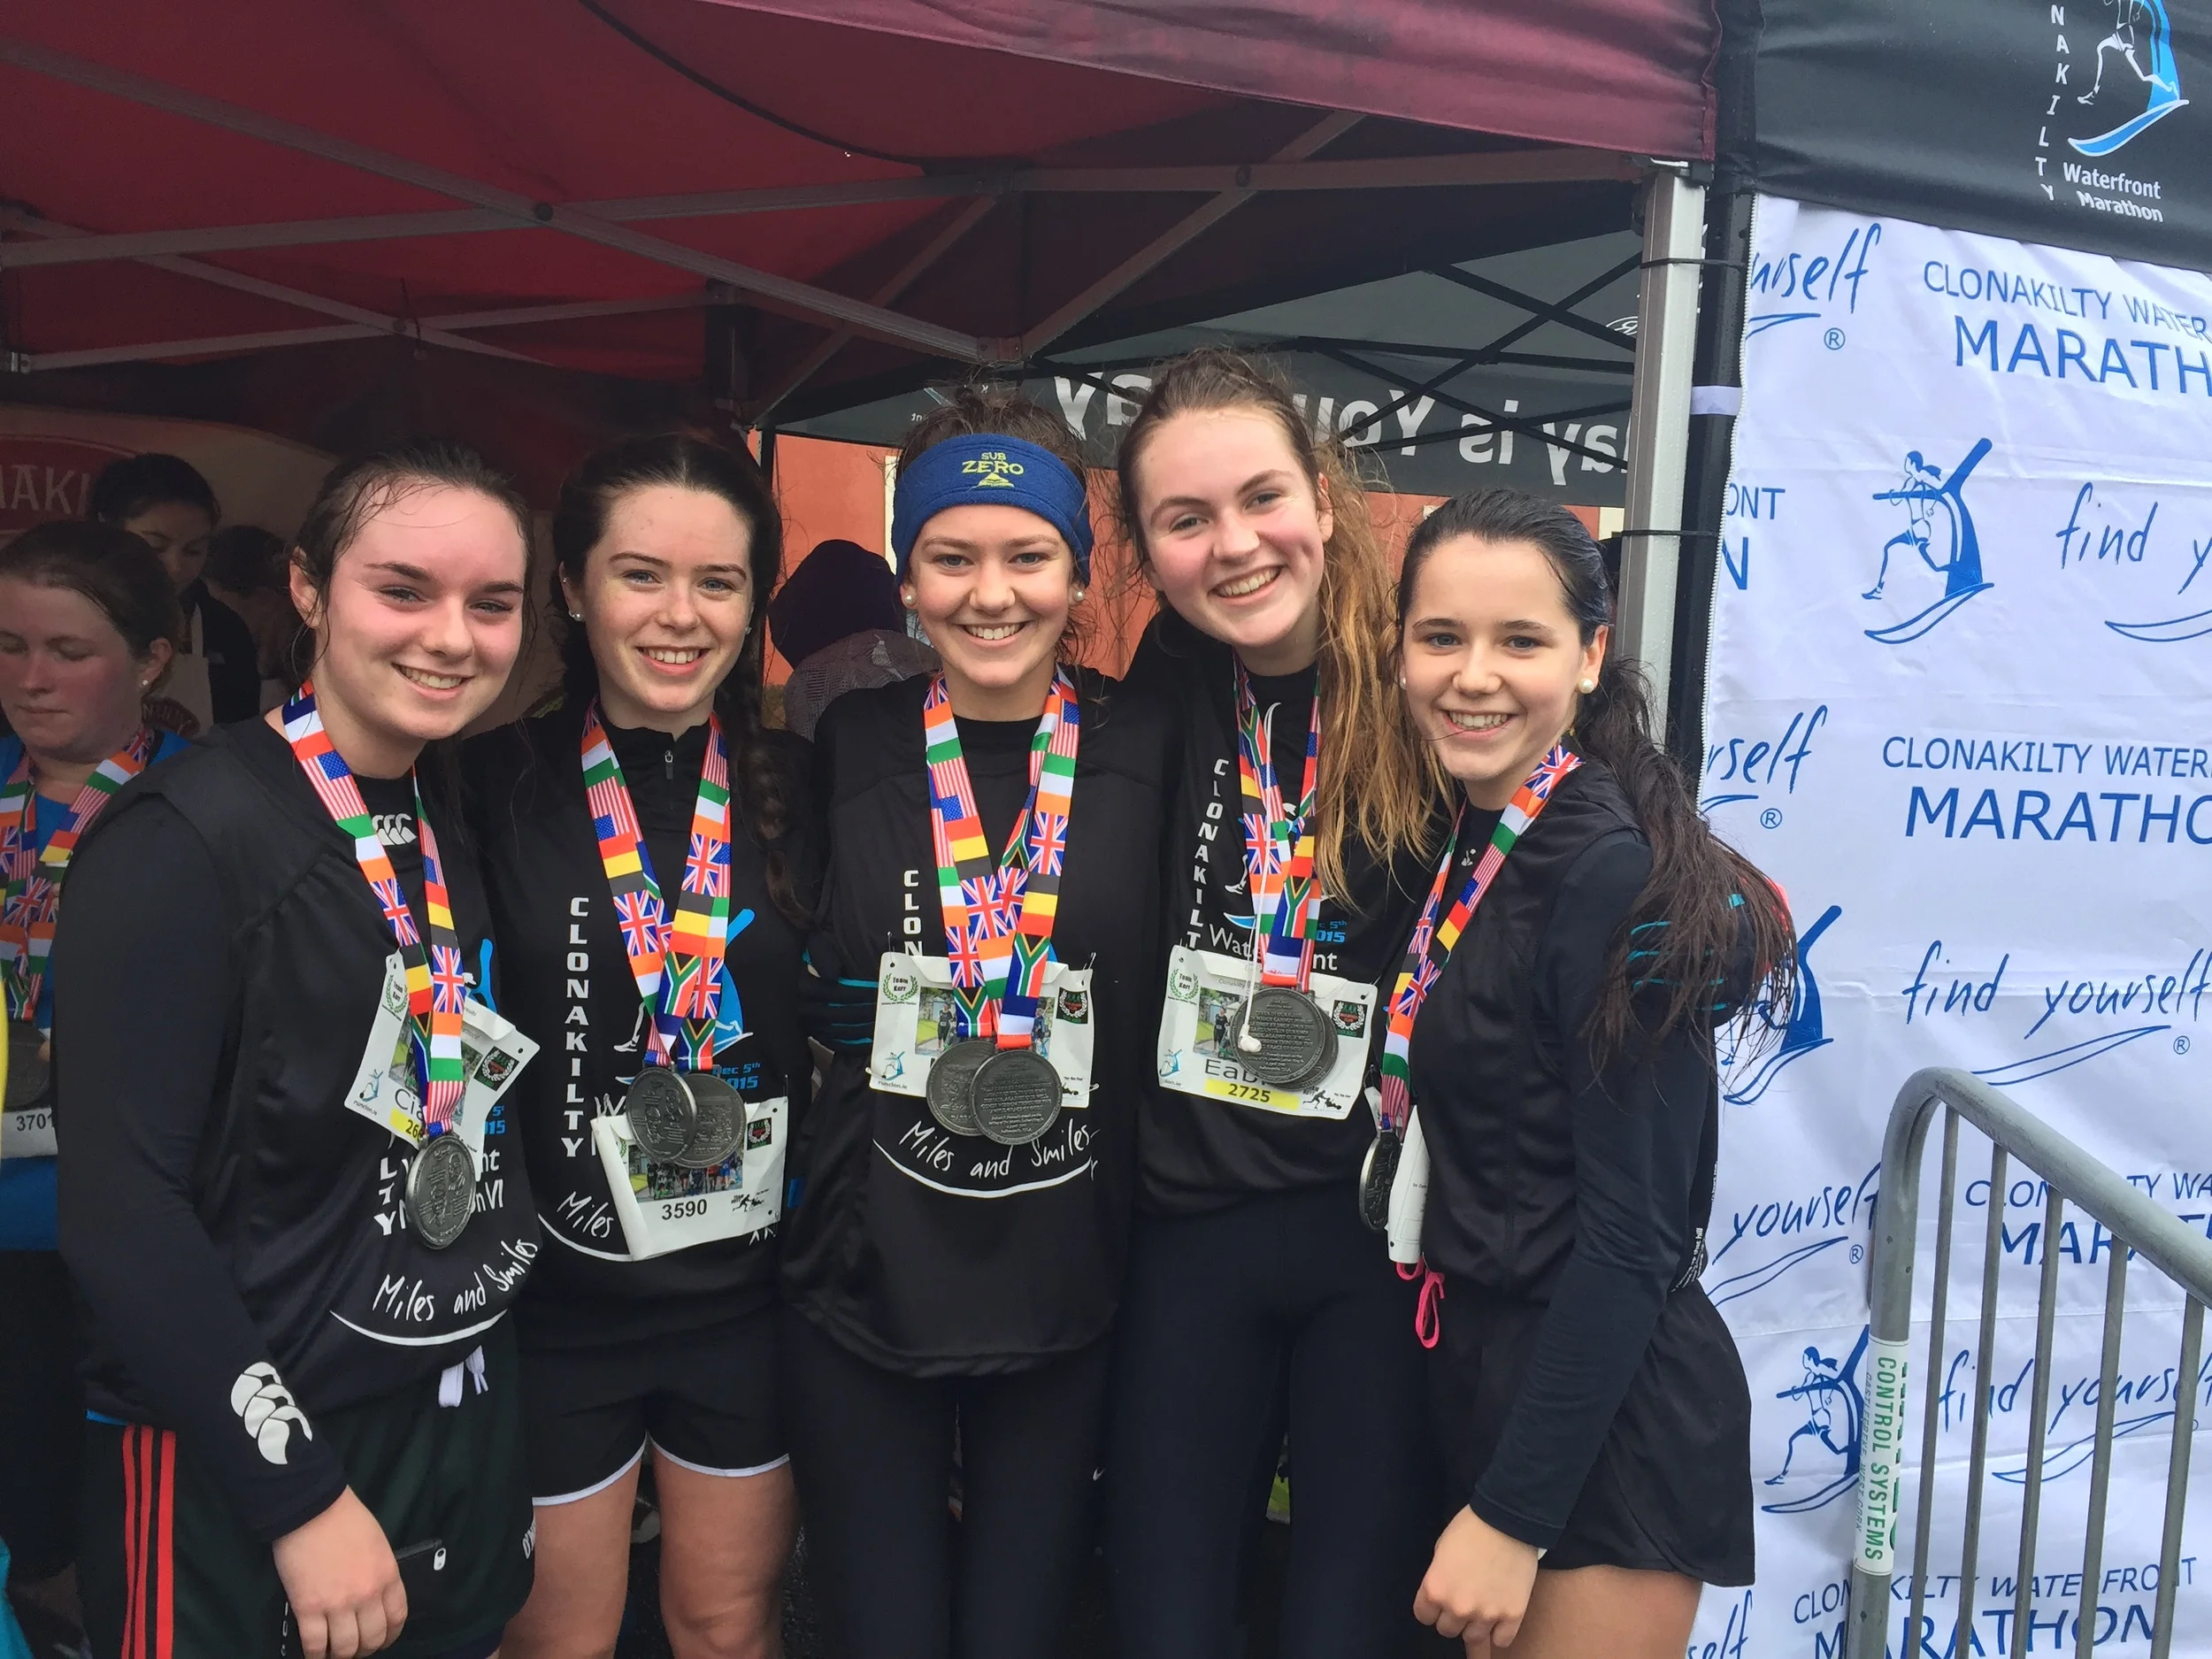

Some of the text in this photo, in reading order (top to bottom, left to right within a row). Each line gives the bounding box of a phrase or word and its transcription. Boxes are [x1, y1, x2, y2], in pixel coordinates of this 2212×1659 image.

[2062, 161, 2162, 200] Waterfront
[2076, 189, 2163, 223] Marathon
[1924, 260, 2113, 320] CLONAKILTY
[1953, 314, 2212, 398] MARATH
[961, 460, 1025, 476] ZERO
[980, 451, 1007, 461] SUB
[0, 465, 90, 518] AKI
[2055, 481, 2159, 571] find
[1882, 735, 2212, 779] CLONAKILTY WATER
[1316, 931, 1347, 943] 015
[1901, 940, 2212, 1040] find yourself
[560, 896, 591, 1158] CLONAKILTY
[726, 1075, 760, 1091] 015
[1227, 1082, 1271, 1103] 2725
[898, 1119, 955, 1171] Miles
[970, 1143, 1014, 1179] and
[1030, 1118, 1091, 1167] Smiles
[557, 1190, 615, 1239] Miles
[661, 1198, 708, 1221] 3590
[372, 1239, 539, 1322] Miles and Smiles
[1864, 1356, 1897, 1561] CONTROL SYSTEMS
[1991, 1557, 2197, 1598] WATEFROT
